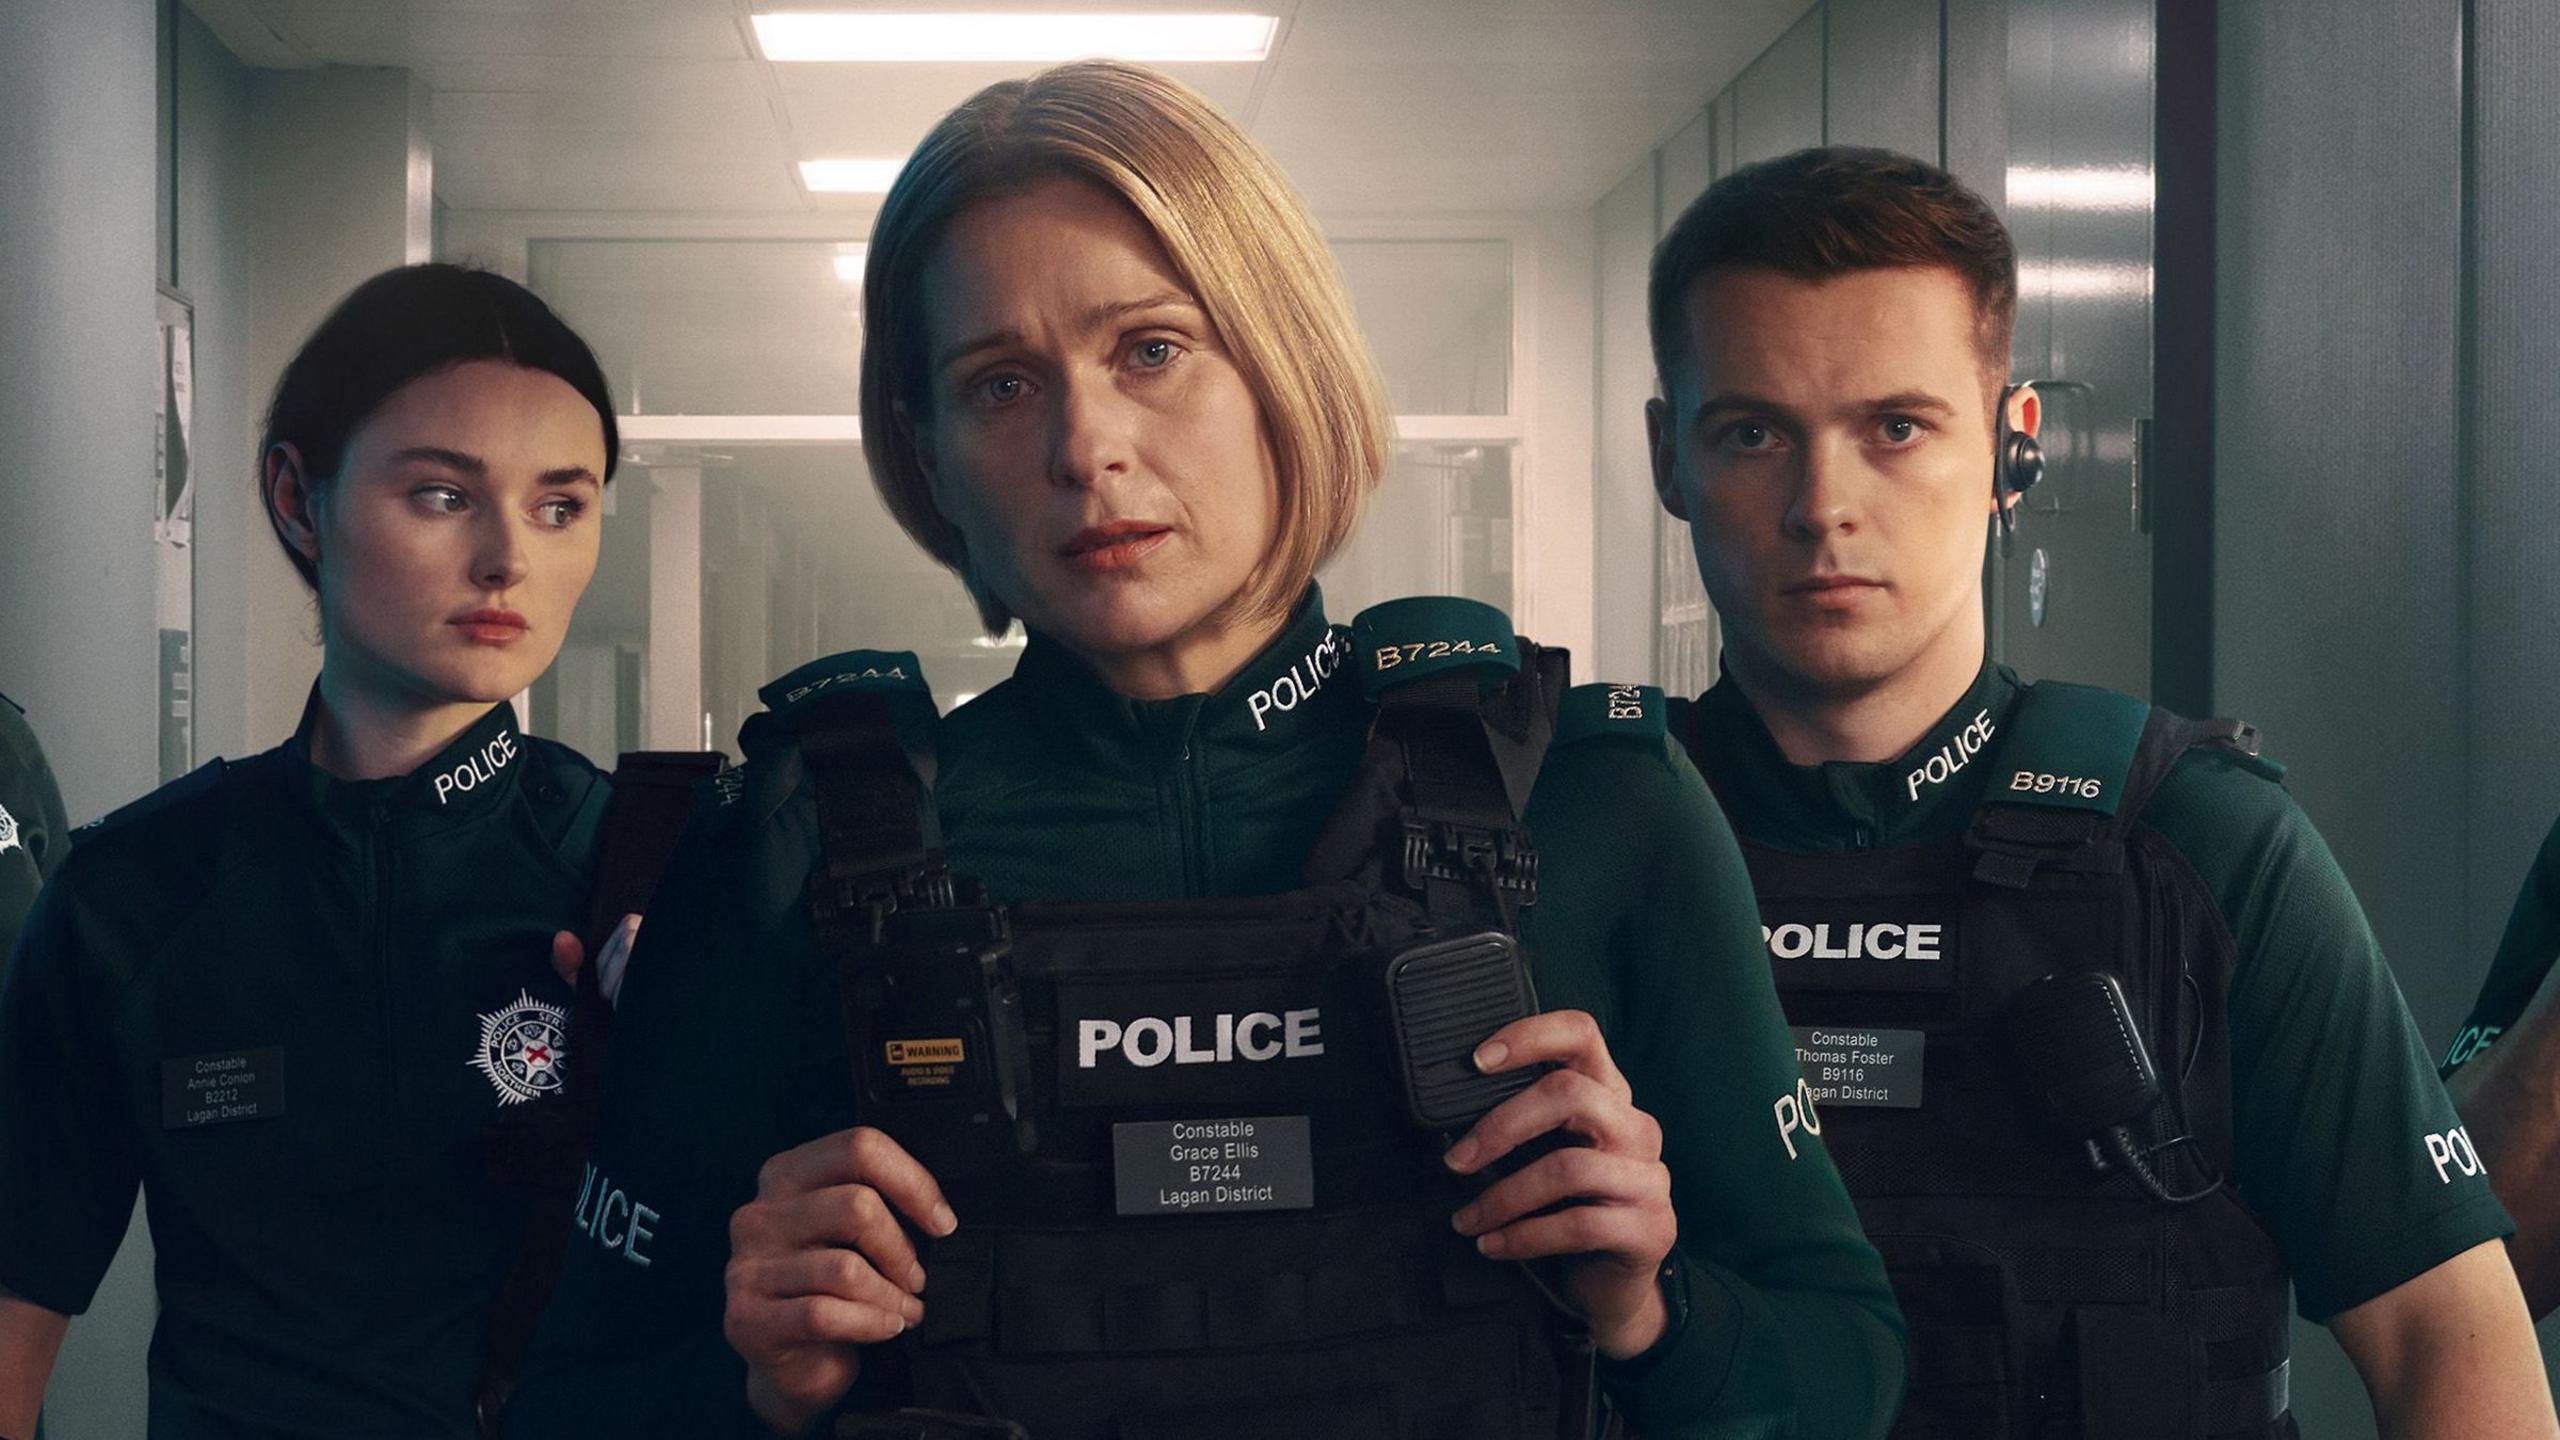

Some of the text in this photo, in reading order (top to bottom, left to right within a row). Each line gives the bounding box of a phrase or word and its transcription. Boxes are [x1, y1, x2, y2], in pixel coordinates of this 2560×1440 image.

[1376, 640, 1502, 671] B7244
[1247, 628, 1340, 732] POLICE
[1907, 708, 1996, 801] POLICE
[434, 729, 517, 804] POLICE
[2010, 771, 2102, 799] B9116
[491, 1013, 521, 1049] POLICE
[1078, 1007, 1325, 1069] POLICE
[1811, 1031, 1879, 1047] Constable
[906, 1045, 960, 1057] WARNING
[1795, 1048, 1895, 1065] Thomas Foster
[195, 1056, 247, 1074] Constable
[1822, 1067, 1865, 1082] B9116
[1806, 1085, 1889, 1101] agan District
[187, 1102, 257, 1124] Lagan District
[1172, 1121, 1255, 1140] Constable
[1170, 1142, 1259, 1161] Grace Ellis
[1190, 1164, 1242, 1182] B7244
[1160, 1185, 1273, 1208] Lagan District
